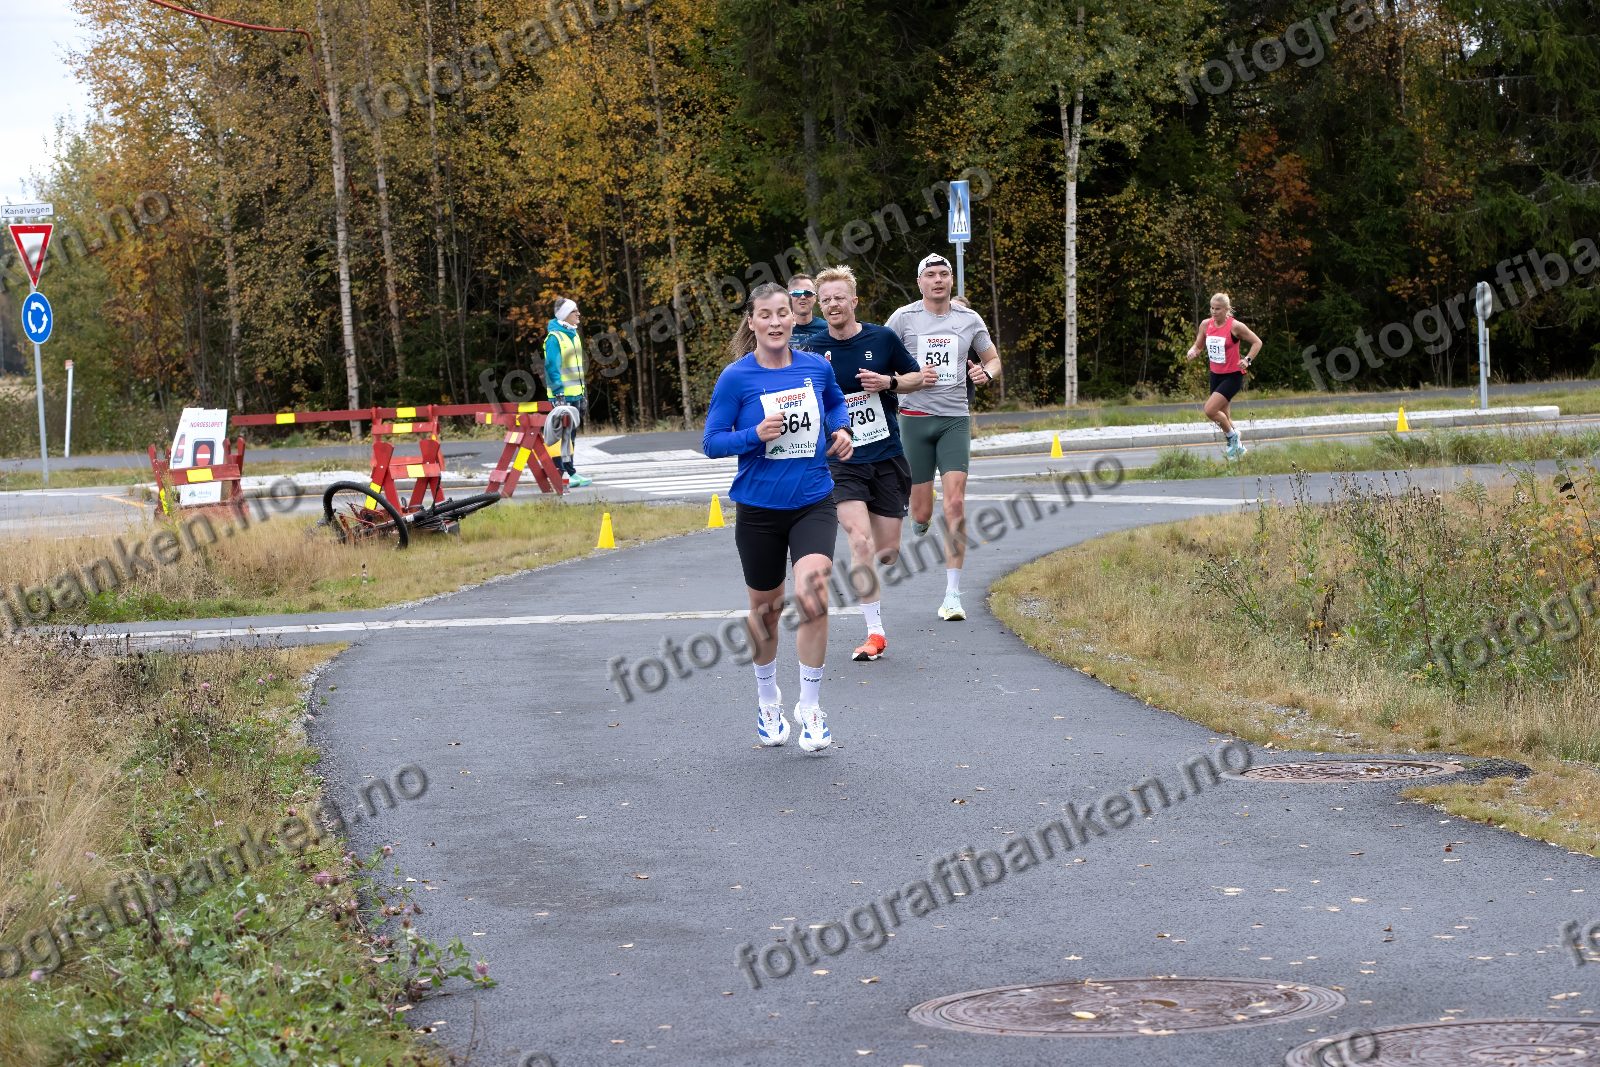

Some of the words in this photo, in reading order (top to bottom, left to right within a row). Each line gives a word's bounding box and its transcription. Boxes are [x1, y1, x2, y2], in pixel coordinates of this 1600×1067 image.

[4, 206, 50, 215] Kanalvegen
[925, 351, 950, 366] 534
[775, 392, 807, 404] NORGES
[780, 400, 803, 409] LØPET
[848, 407, 876, 427] 730
